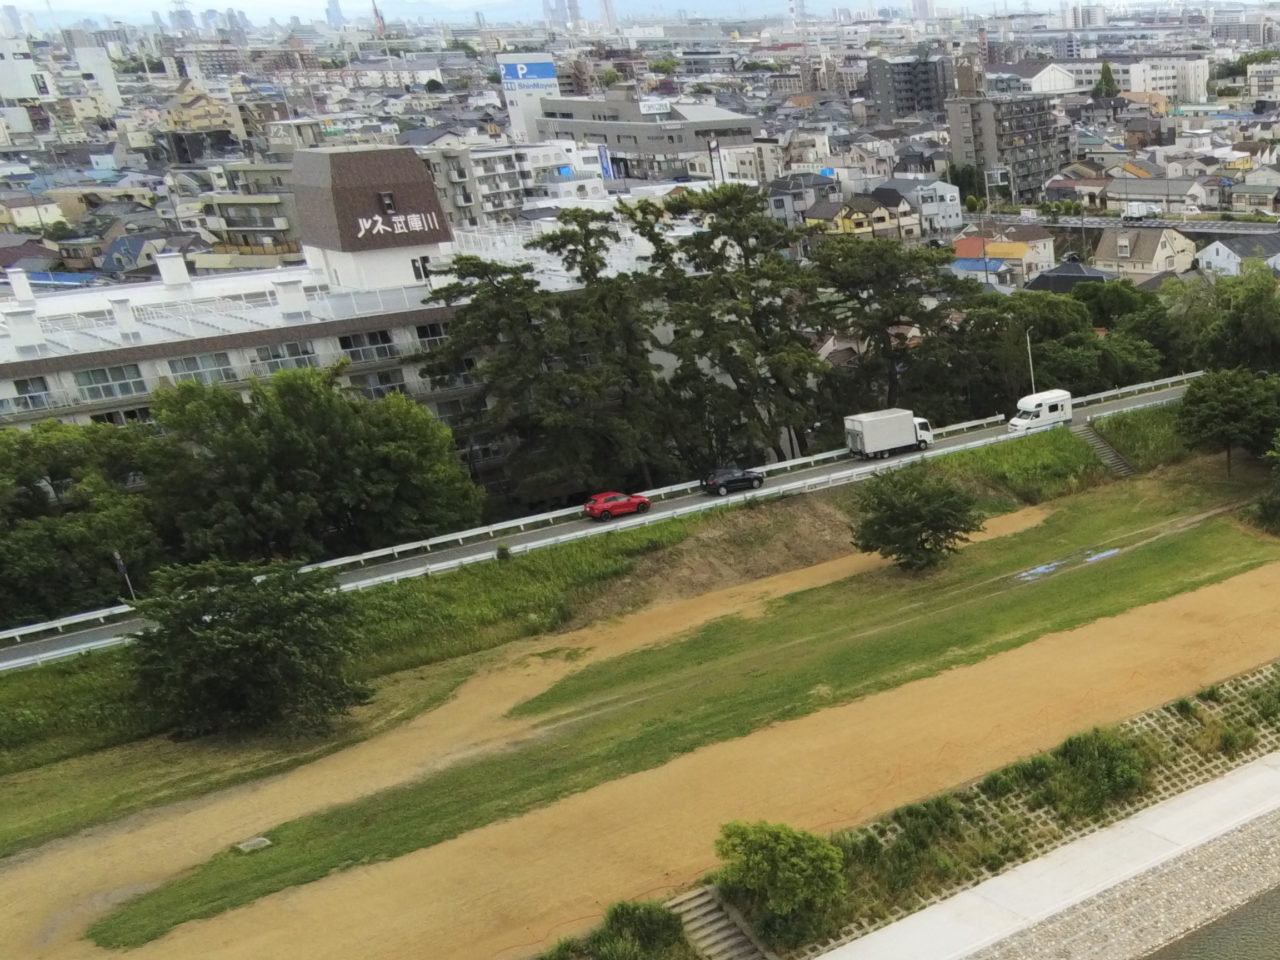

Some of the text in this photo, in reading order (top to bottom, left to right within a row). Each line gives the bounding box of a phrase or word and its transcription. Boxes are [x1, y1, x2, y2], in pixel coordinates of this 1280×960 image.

[517, 64, 527, 78] P
[357, 212, 440, 238] ルネ武庫川
